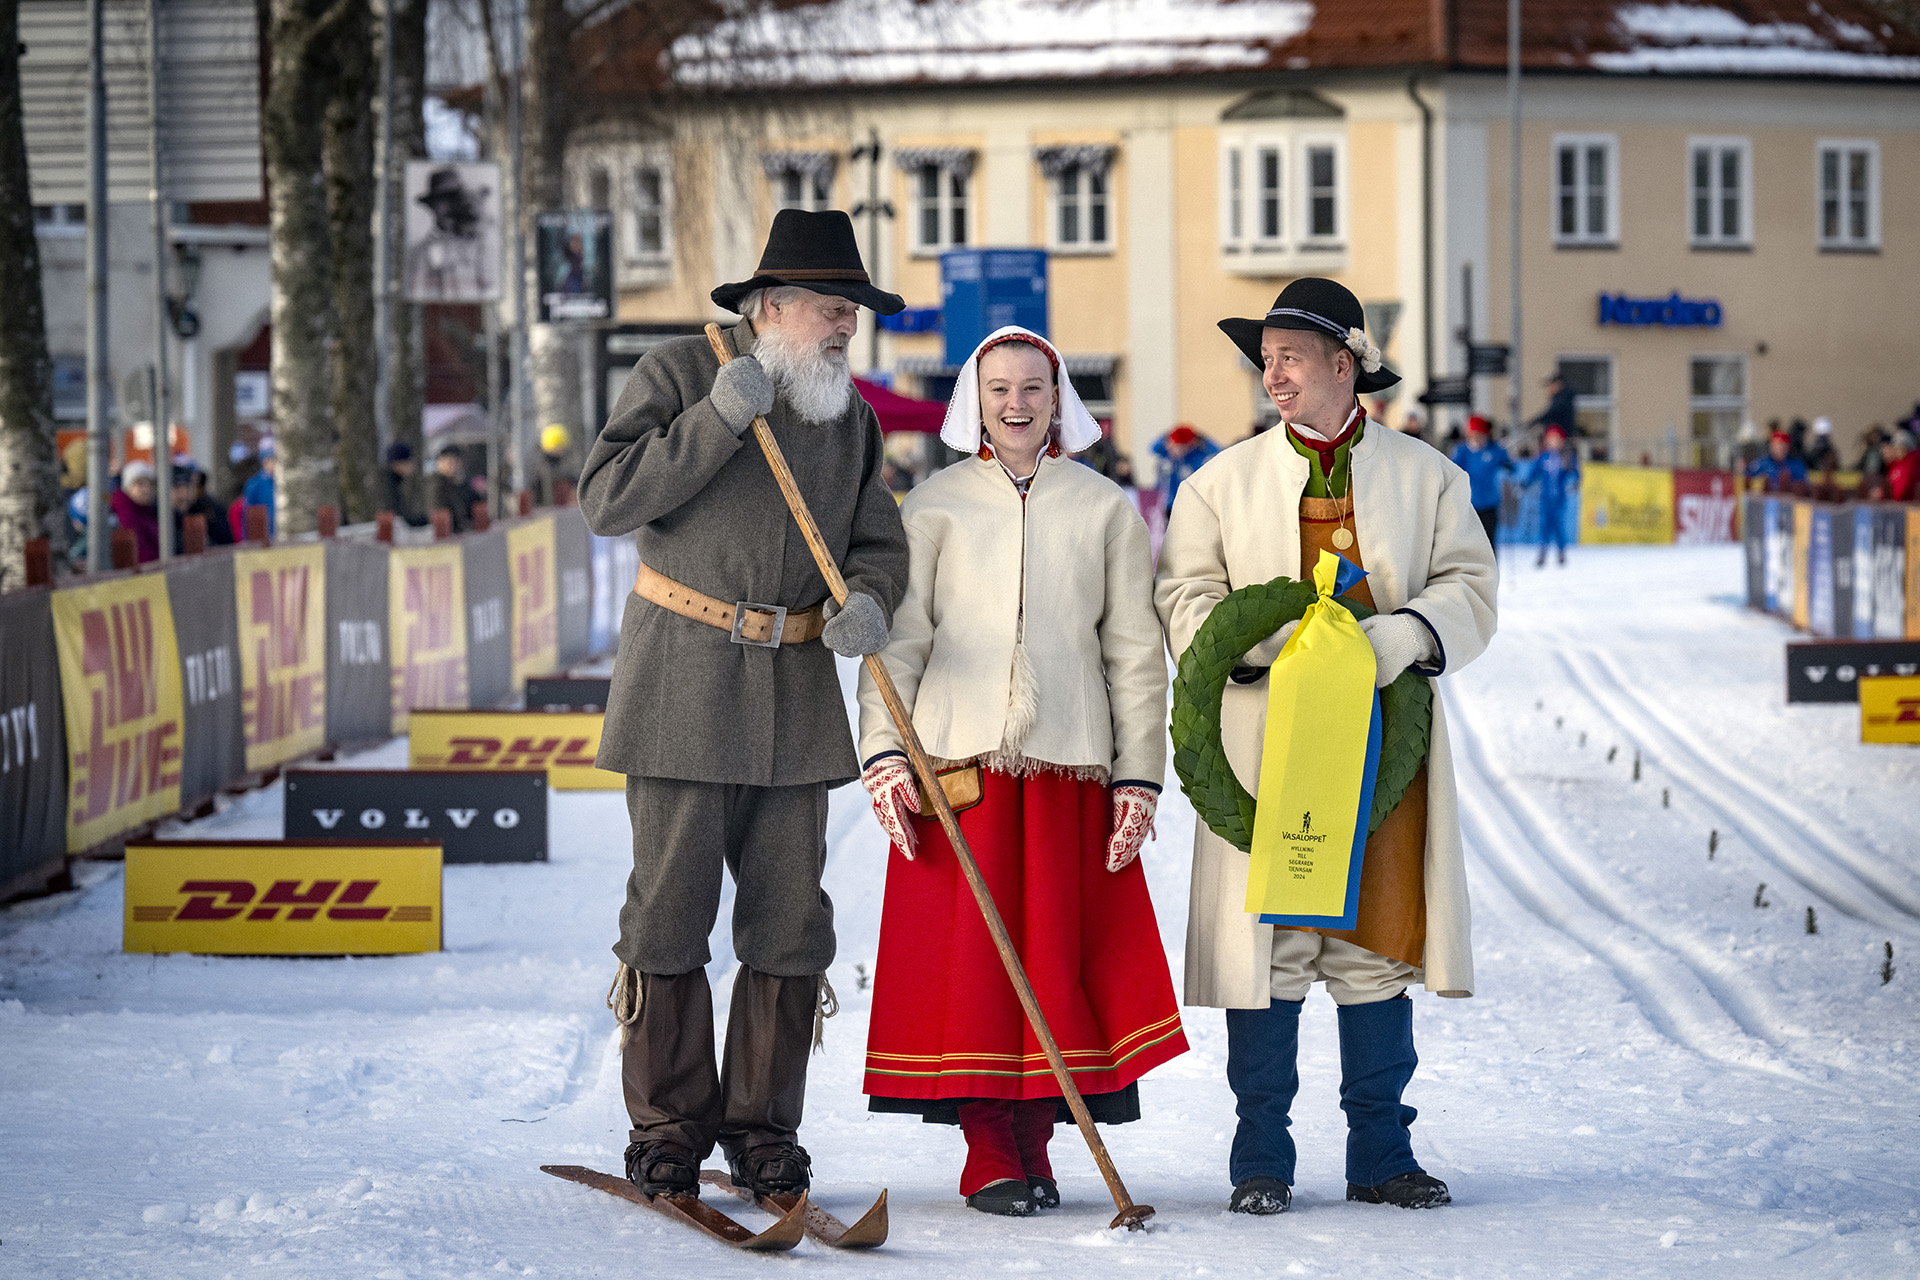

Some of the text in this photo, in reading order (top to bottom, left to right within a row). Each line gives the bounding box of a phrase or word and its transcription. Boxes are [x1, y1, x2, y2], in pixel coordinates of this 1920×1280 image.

[447, 736, 596, 768] DHL
[312, 808, 520, 829] VOLVO
[1282, 831, 1327, 843] VASALOPPET
[174, 880, 391, 921] DHL
